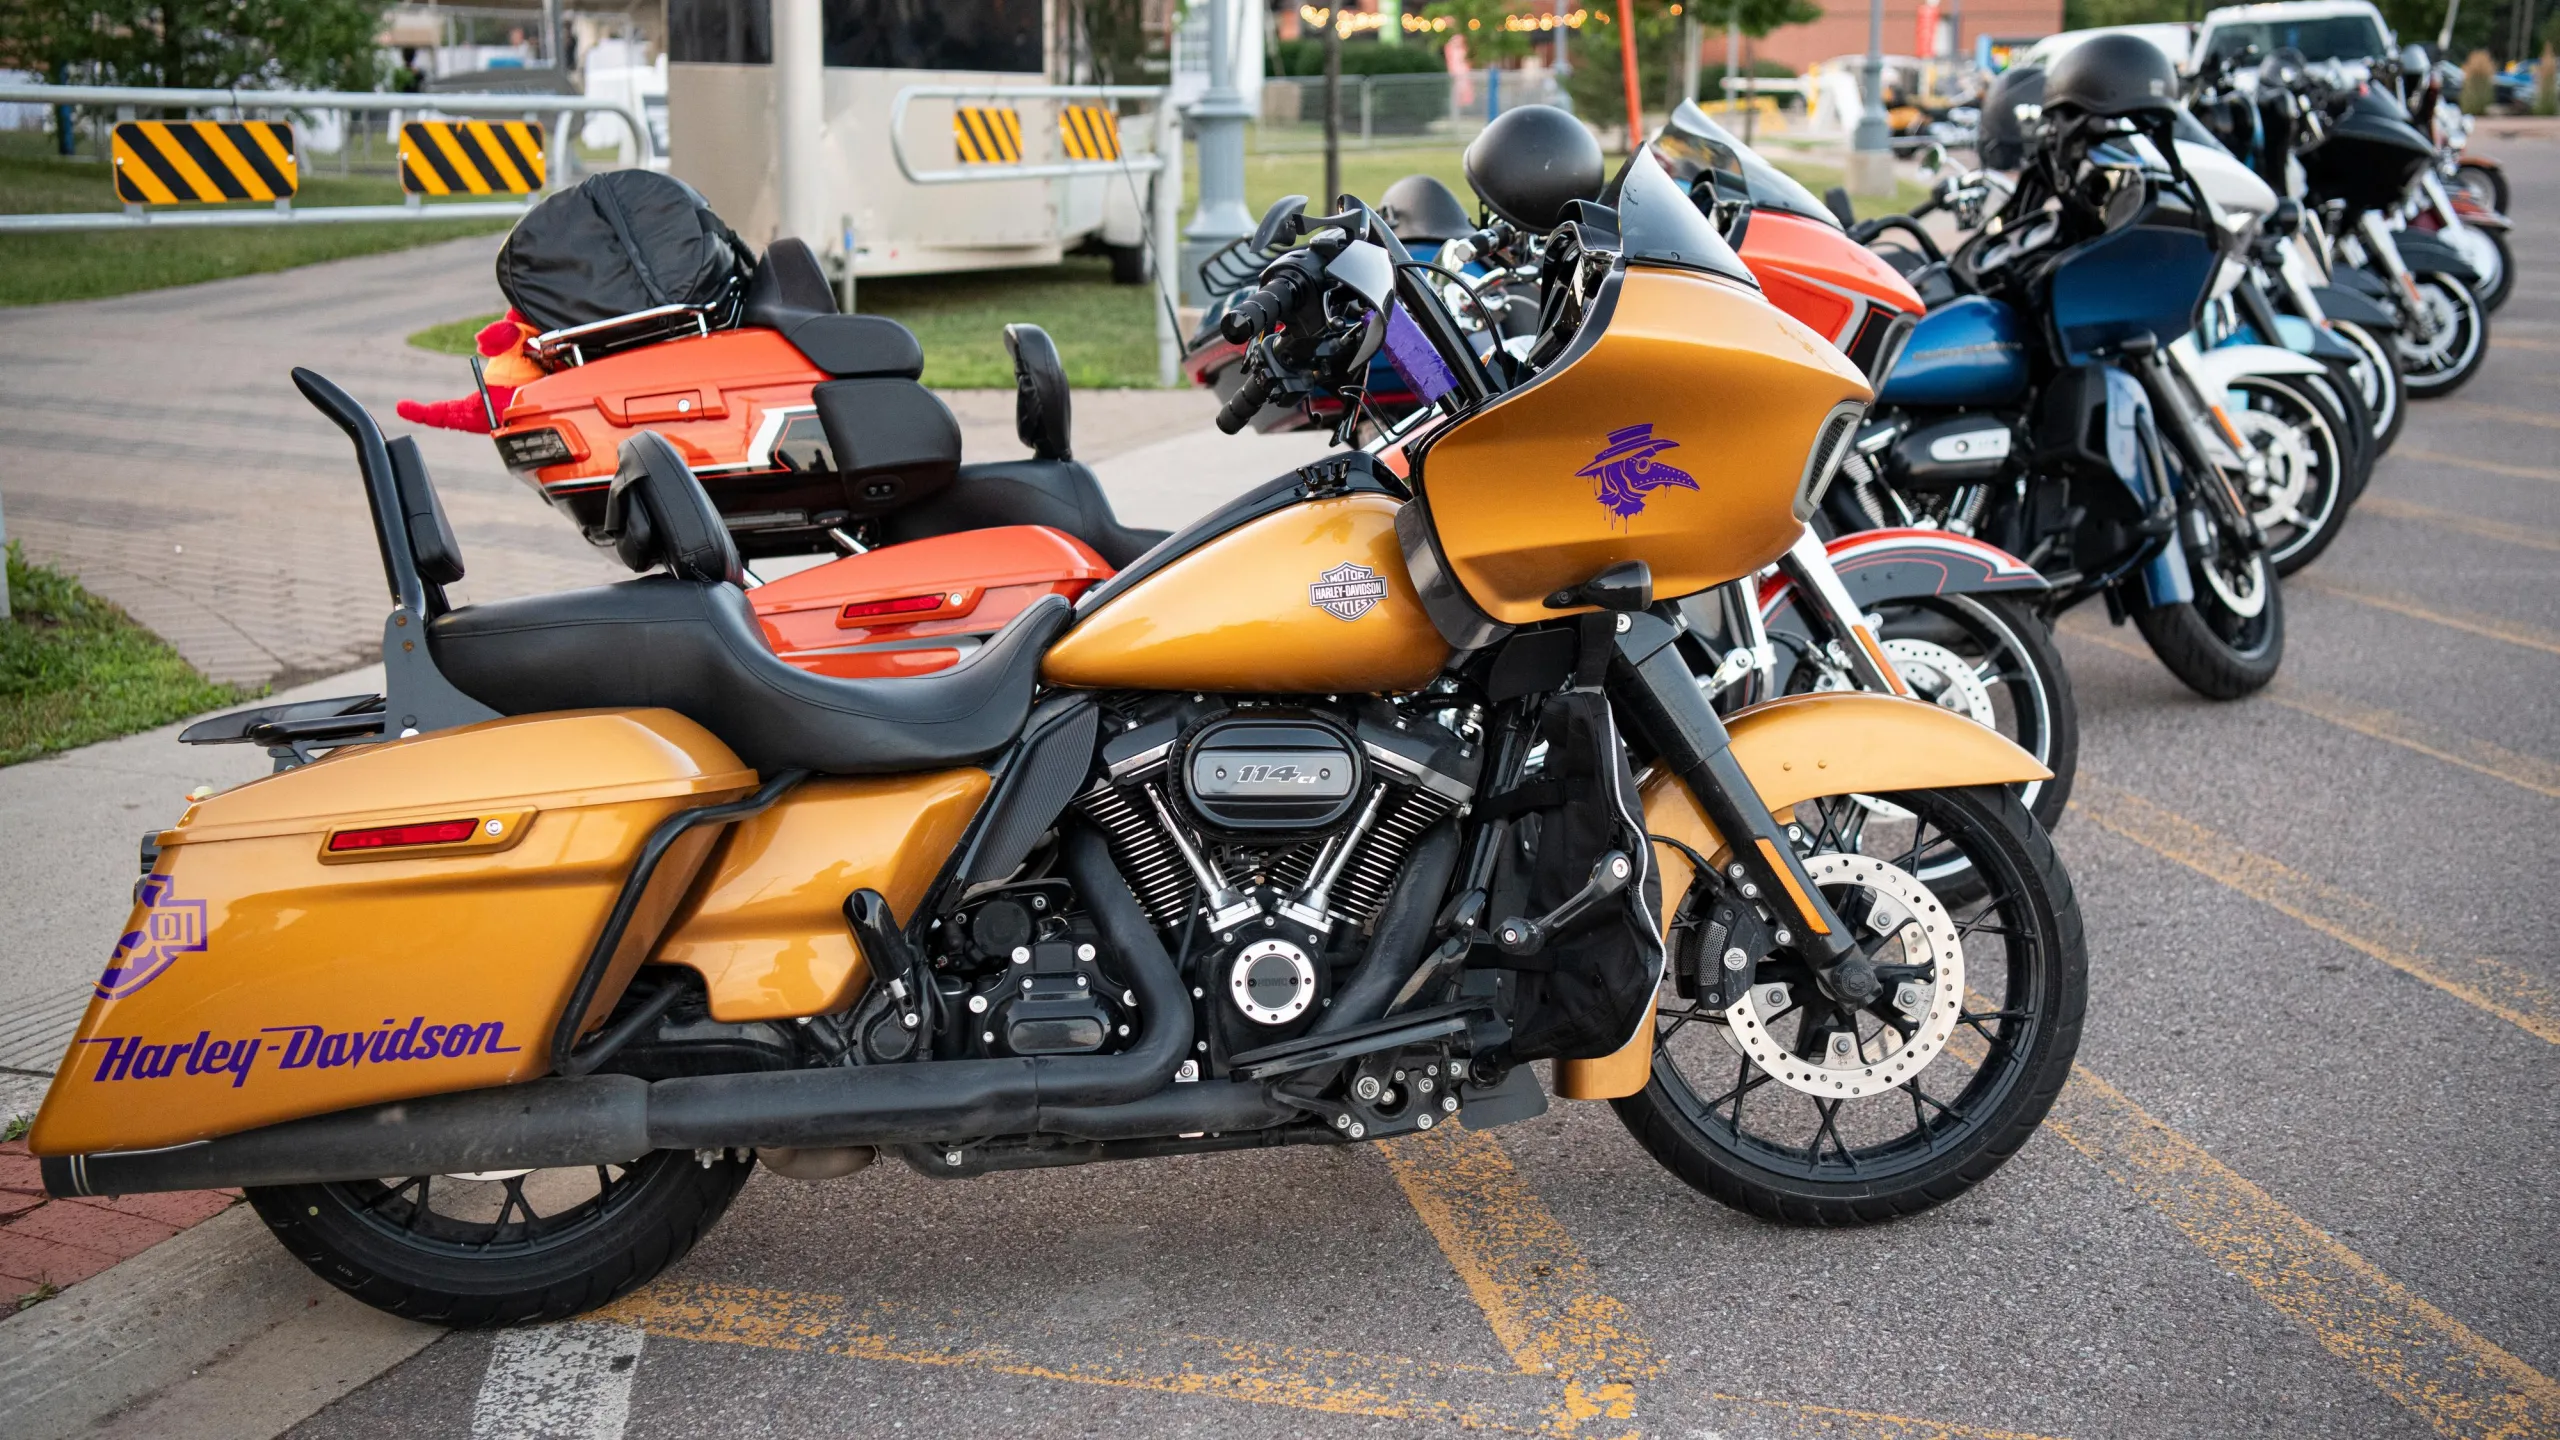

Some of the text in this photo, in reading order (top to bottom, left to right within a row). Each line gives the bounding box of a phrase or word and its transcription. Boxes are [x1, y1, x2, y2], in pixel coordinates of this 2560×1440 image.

[1329, 567, 1366, 583] MOTOR
[1315, 581, 1382, 600] HARLEY-DAVIDSON
[1331, 598, 1368, 616] CYCLES
[79, 1016, 521, 1088] Harley-Davidson
